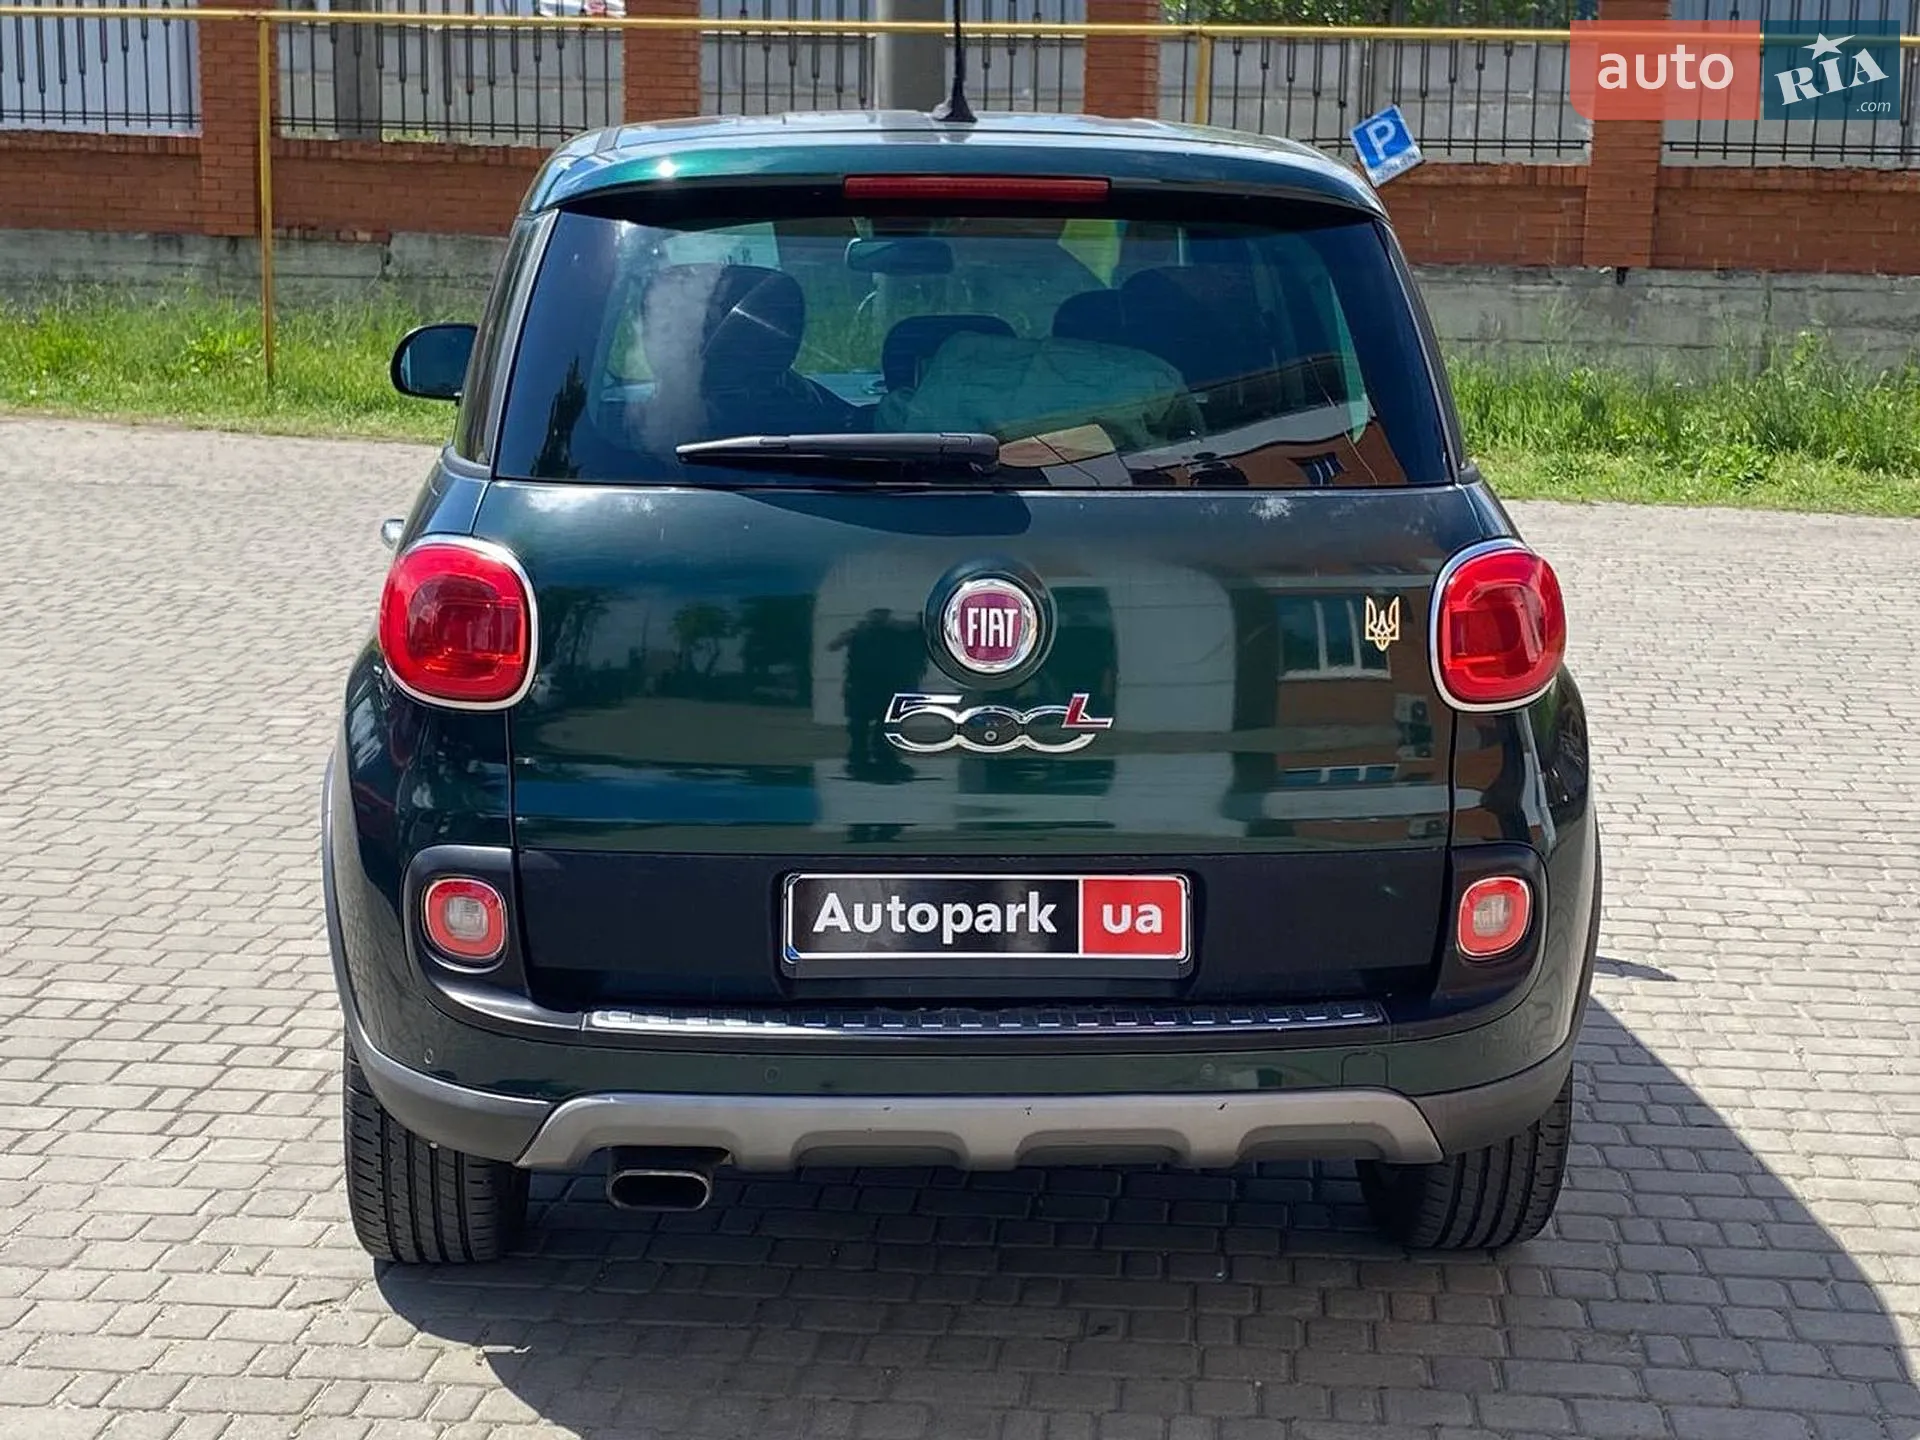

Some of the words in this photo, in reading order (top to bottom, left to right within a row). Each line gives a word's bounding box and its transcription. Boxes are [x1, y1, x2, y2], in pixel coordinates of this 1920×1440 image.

[1366, 119, 1396, 161] P
[967, 608, 1018, 648] FIAT
[812, 892, 1057, 944] Autopark
[1102, 905, 1163, 933] ua
